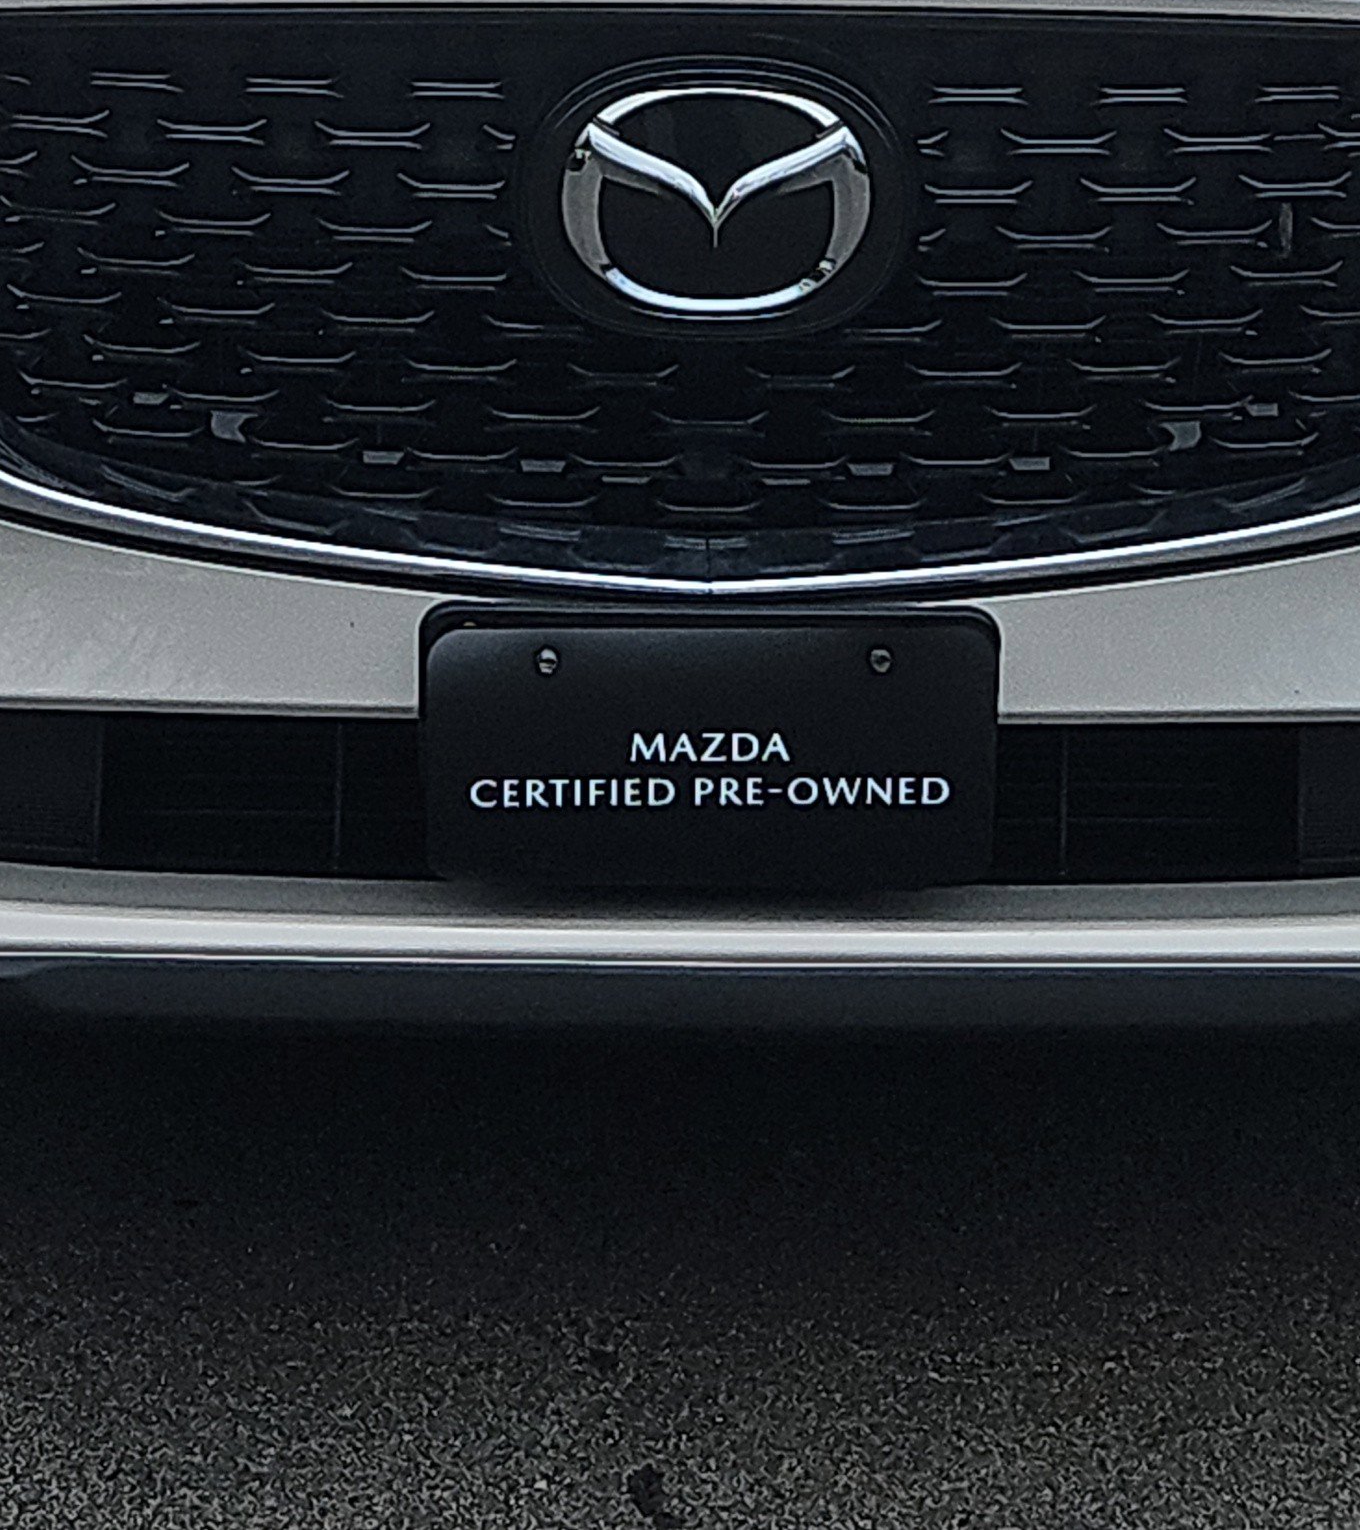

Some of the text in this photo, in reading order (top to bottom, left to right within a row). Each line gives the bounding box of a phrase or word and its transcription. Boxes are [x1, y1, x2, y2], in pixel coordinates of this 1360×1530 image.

[629, 732, 791, 762] MAZDA
[469, 776, 951, 808] CERTIFIED PRE-OWNED
